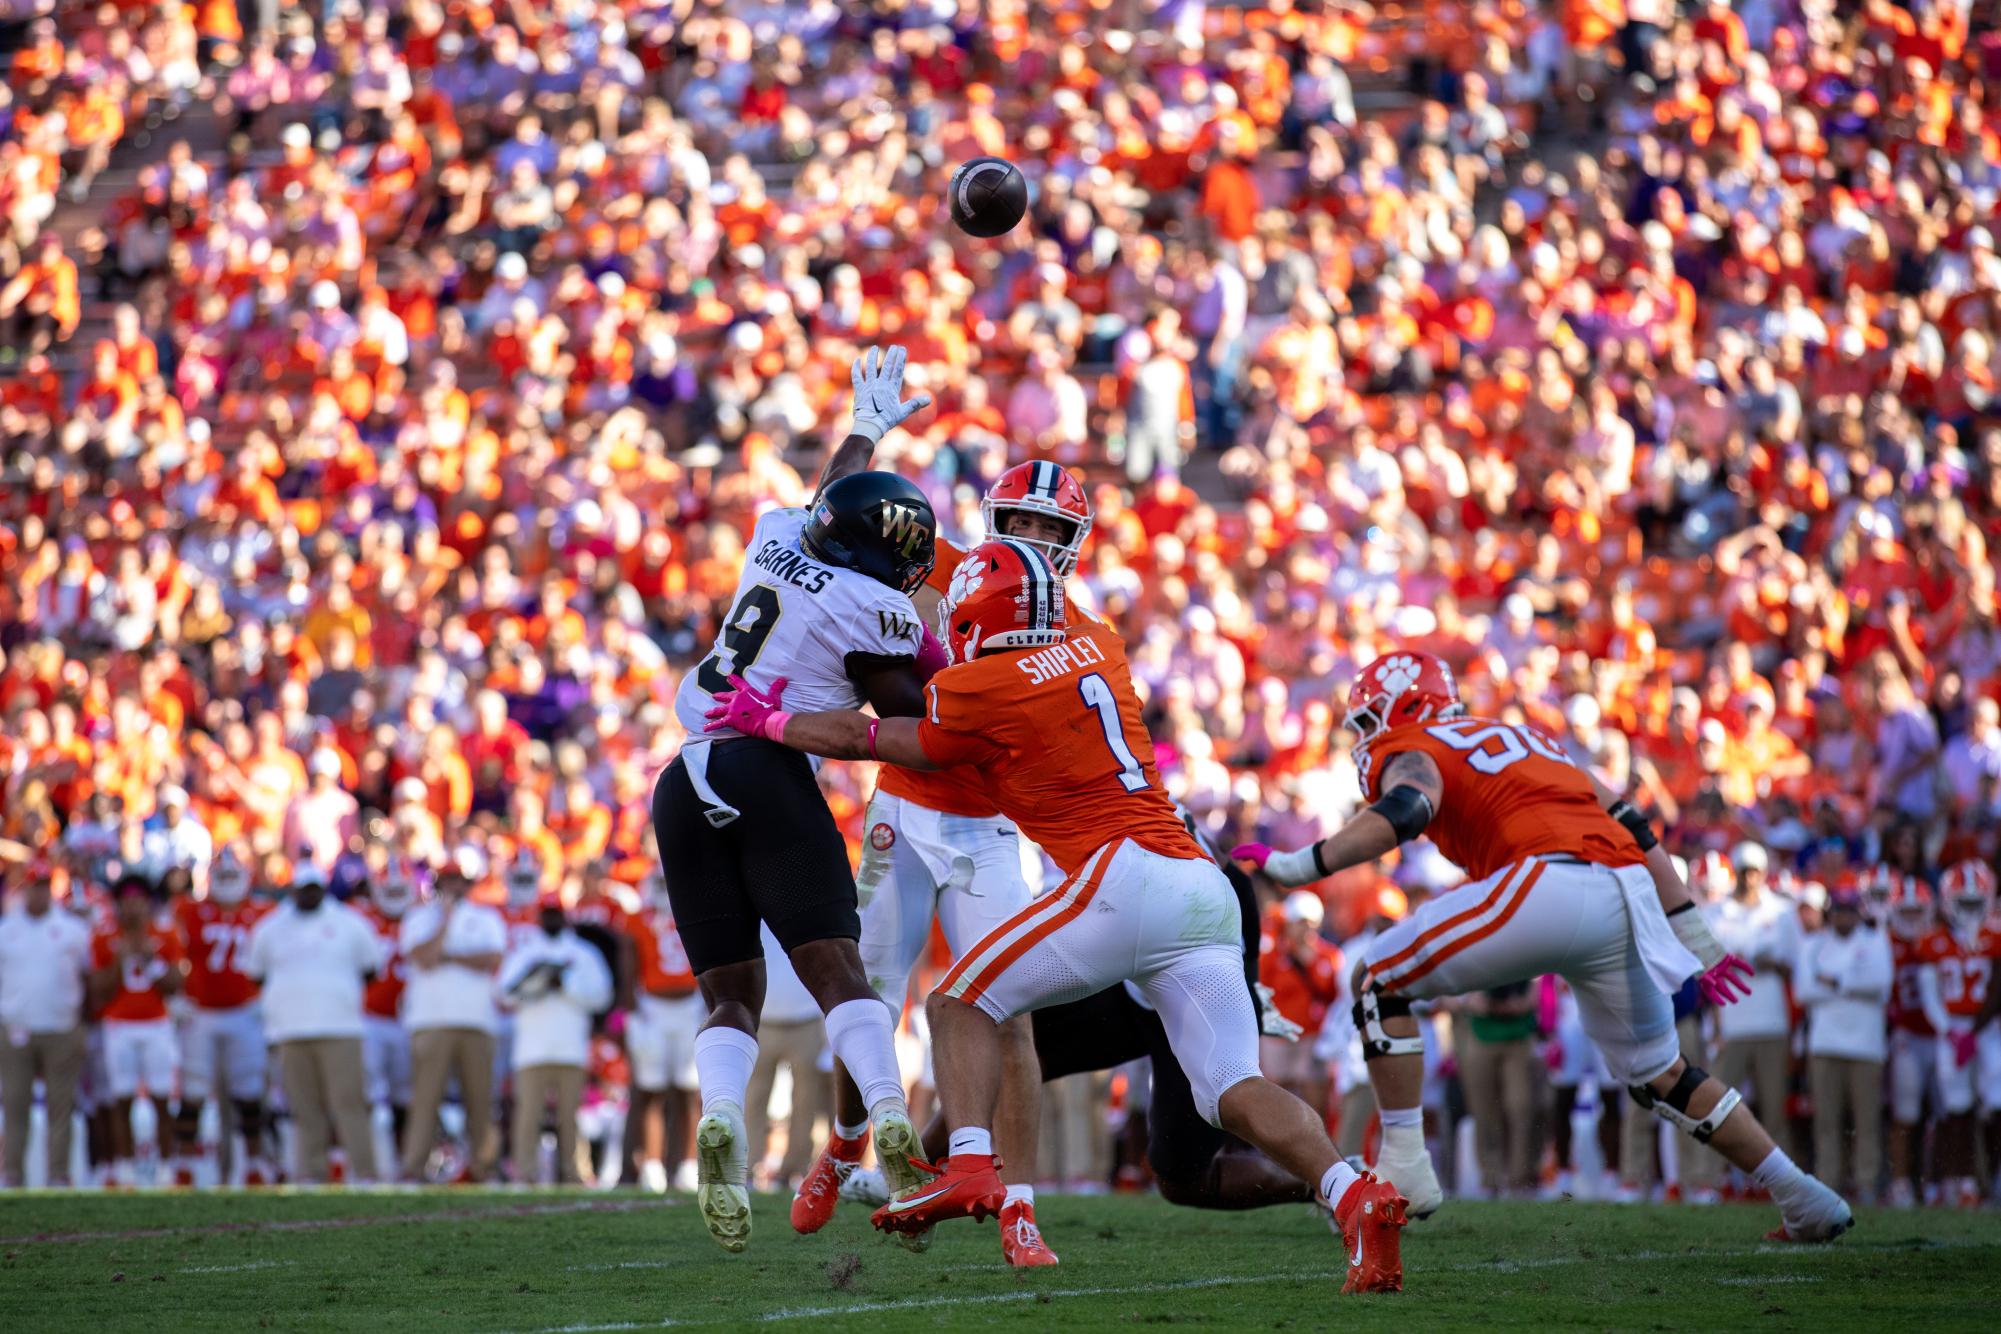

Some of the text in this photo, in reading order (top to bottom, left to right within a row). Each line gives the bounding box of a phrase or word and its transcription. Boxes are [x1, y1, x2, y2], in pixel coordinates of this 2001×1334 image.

[754, 539, 835, 595] GARNES
[696, 581, 784, 697] 9
[1016, 635, 1106, 685] SHIPLEY
[929, 684, 940, 725] 1
[1076, 671, 1152, 794] 1
